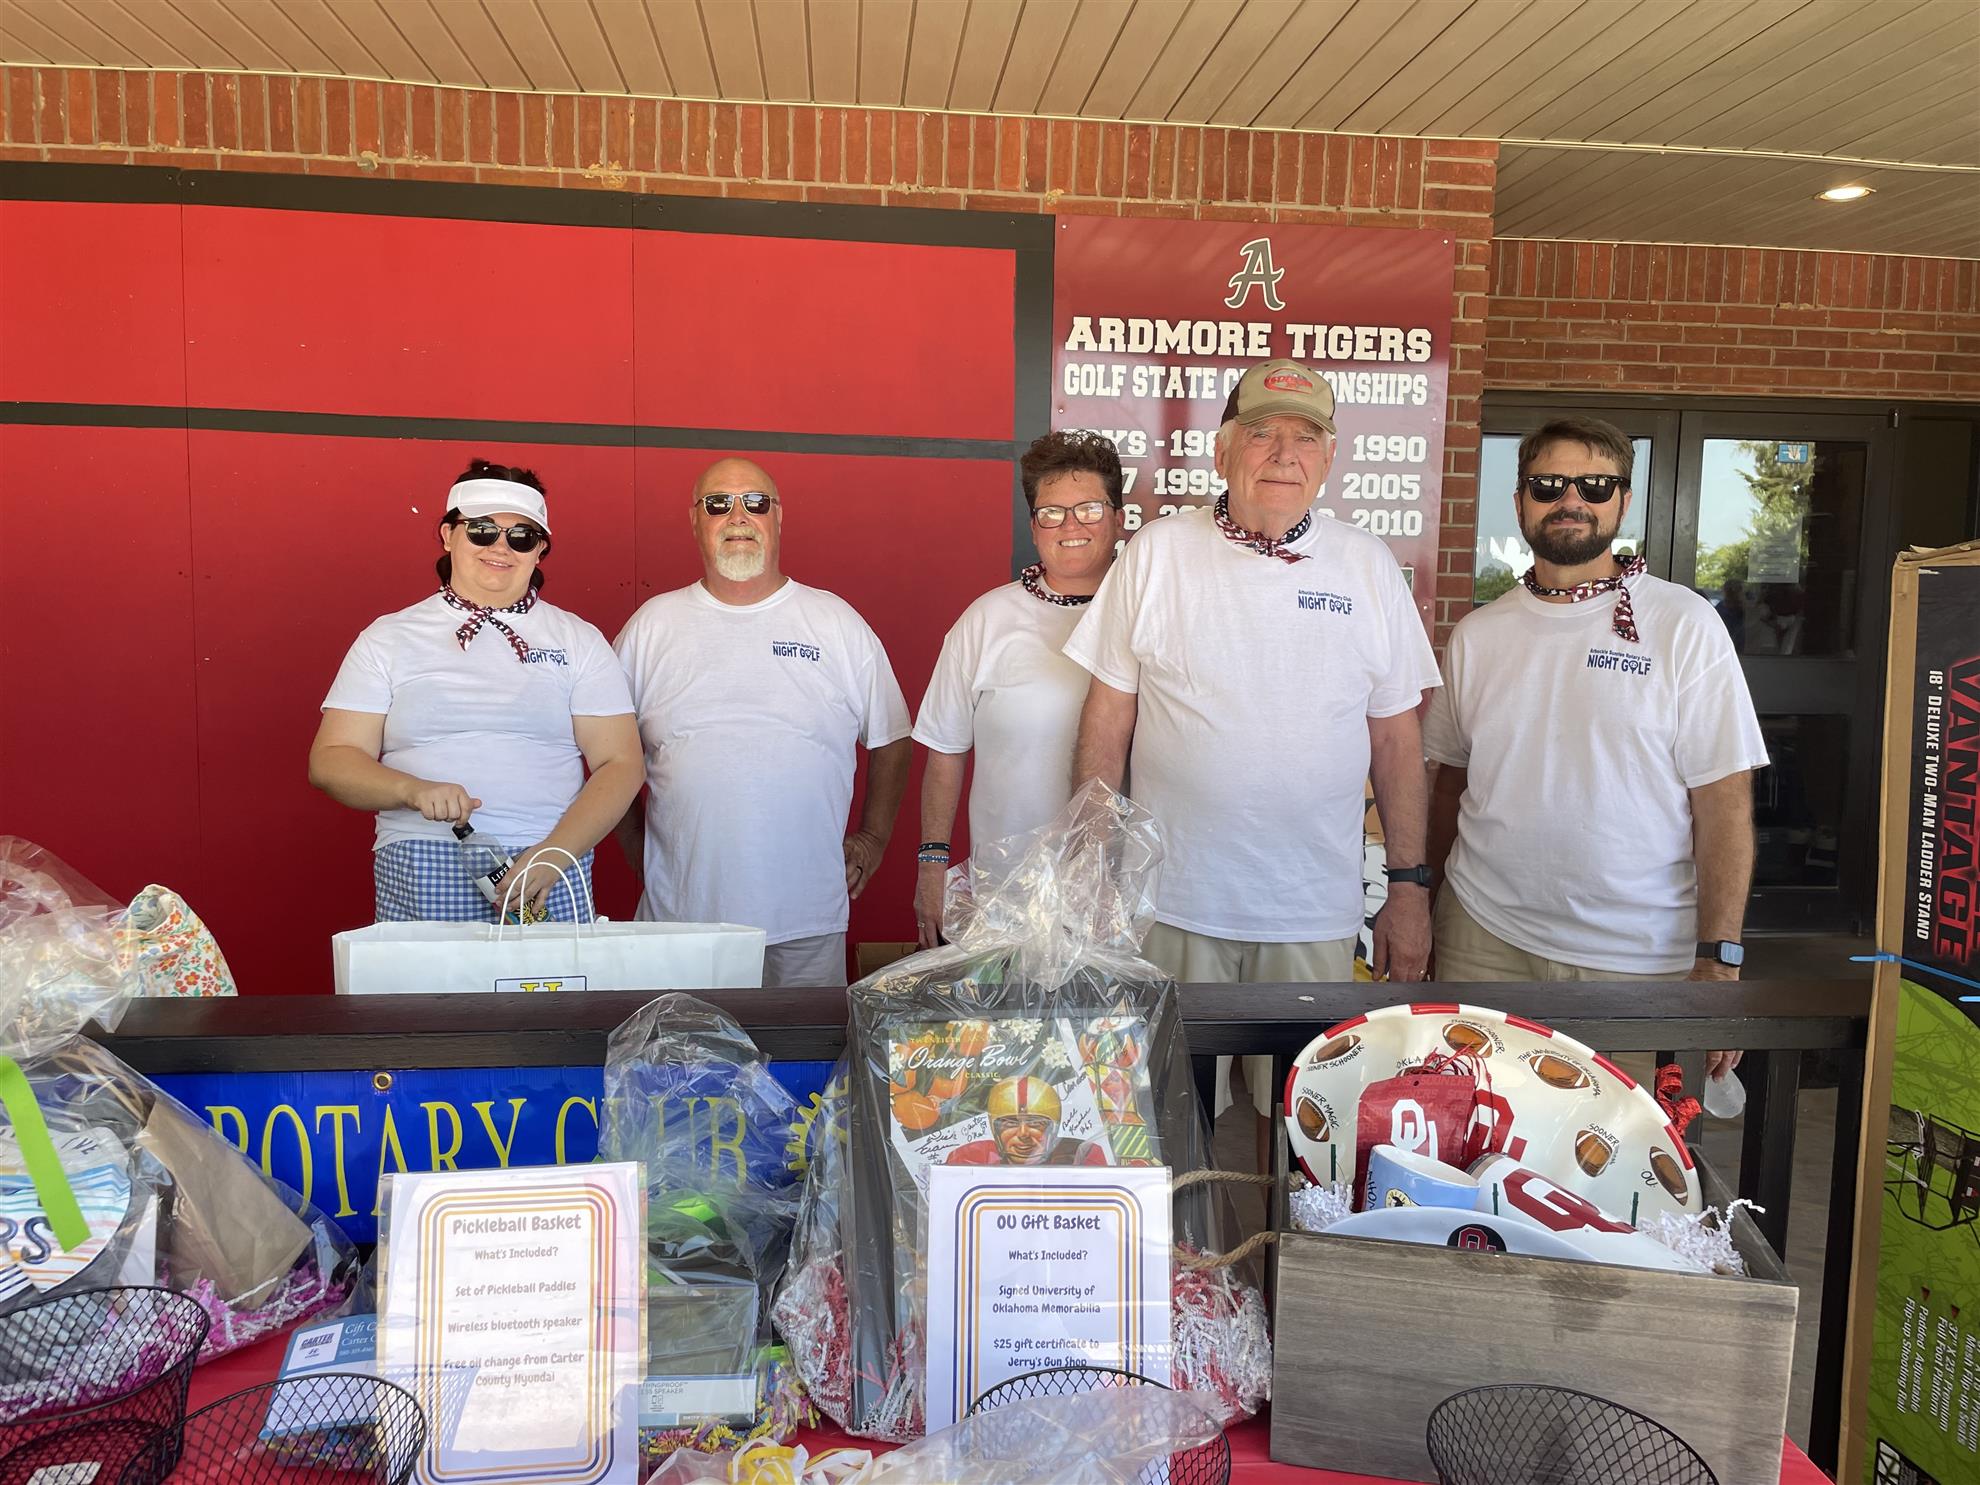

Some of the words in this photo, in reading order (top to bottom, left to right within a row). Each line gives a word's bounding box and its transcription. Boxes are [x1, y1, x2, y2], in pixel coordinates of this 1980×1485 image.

[1065, 316, 1273, 358] ARDMORE
[1286, 323, 1433, 363] TIGERS
[1064, 363, 1127, 397] GOLF
[1132, 364, 1218, 400] STATE
[1223, 367, 1428, 405] CONSHIPS
[1353, 434, 1427, 463] 1990
[1342, 473, 1421, 501] 2005
[1351, 509, 1423, 537] 2010
[1298, 595, 1327, 611] NIGHT
[1329, 599, 1353, 615] GOLF
[549, 653, 568, 666] GOL
[773, 645, 798, 658] NIGHT
[799, 648, 820, 662] GOLF
[1587, 654, 1619, 670] NIGHT
[1621, 659, 1651, 676] GOLF
[1929, 670, 1944, 691] 18'
[1926, 696, 1942, 750] DELUXE
[1922, 754, 1940, 829] TWO-MAN
[1936, 657, 1980, 963] VANTAGE
[1919, 832, 1935, 889] LADDER
[1916, 892, 1932, 941] STAND
[907, 1046, 975, 1080] Orange
[979, 1044, 1034, 1067] Bowl
[1588, 1122, 1620, 1147] SOONER
[205, 1098, 519, 1218] ROTARY
[453, 1216, 527, 1235] Pickleball
[531, 1213, 582, 1232] Basket
[996, 1214, 1017, 1230] OU
[1021, 1214, 1050, 1231] Gift
[1053, 1214, 1101, 1231] Basket
[474, 1248, 507, 1260] What's
[508, 1246, 560, 1259] Included?
[1008, 1250, 1039, 1261] What's
[1041, 1249, 1089, 1261] Included?
[455, 1286, 472, 1298] Set
[473, 1284, 486, 1296] of
[487, 1283, 537, 1296] Pickleball
[538, 1281, 577, 1293] Paddles
[999, 1284, 1030, 1299] Signed
[1032, 1284, 1082, 1299] University
[1084, 1284, 1097, 1296] of
[992, 1302, 1039, 1314] Oklahoma
[1041, 1302, 1101, 1314] Memorabilia
[1902, 1296, 1916, 1338] Flip-up
[448, 1321, 489, 1333] Wireless
[490, 1318, 541, 1331] bluetooth
[543, 1316, 583, 1331] speaker
[1917, 1305, 1929, 1350] Padded
[1937, 1316, 1948, 1339] Full
[1949, 1322, 1958, 1346] 37"
[993, 1338, 1012, 1350] $25
[1014, 1338, 1033, 1352] gift
[1035, 1338, 1088, 1350] certificate
[1089, 1339, 1100, 1350] to
[1934, 1340, 1946, 1366] Foot
[1947, 1346, 1956, 1358] X
[1963, 1333, 1977, 1365] Mesh
[444, 1358, 467, 1370] Free
[469, 1357, 483, 1369] oil
[484, 1355, 521, 1371] change
[523, 1353, 549, 1366] from
[550, 1353, 585, 1365] Carter
[1007, 1356, 1041, 1370] Jerry's
[1043, 1356, 1063, 1367] Gun
[1064, 1356, 1087, 1368] Shop
[1896, 1338, 1912, 1388] Shooting
[475, 1374, 512, 1388] County
[514, 1371, 556, 1388] Hyundai
[1910, 1353, 1925, 1413] Adjustable
[1928, 1366, 1942, 1417] Platform
[1957, 1367, 1971, 1409] Flip-up
[1939, 1380, 1954, 1432] Premium
